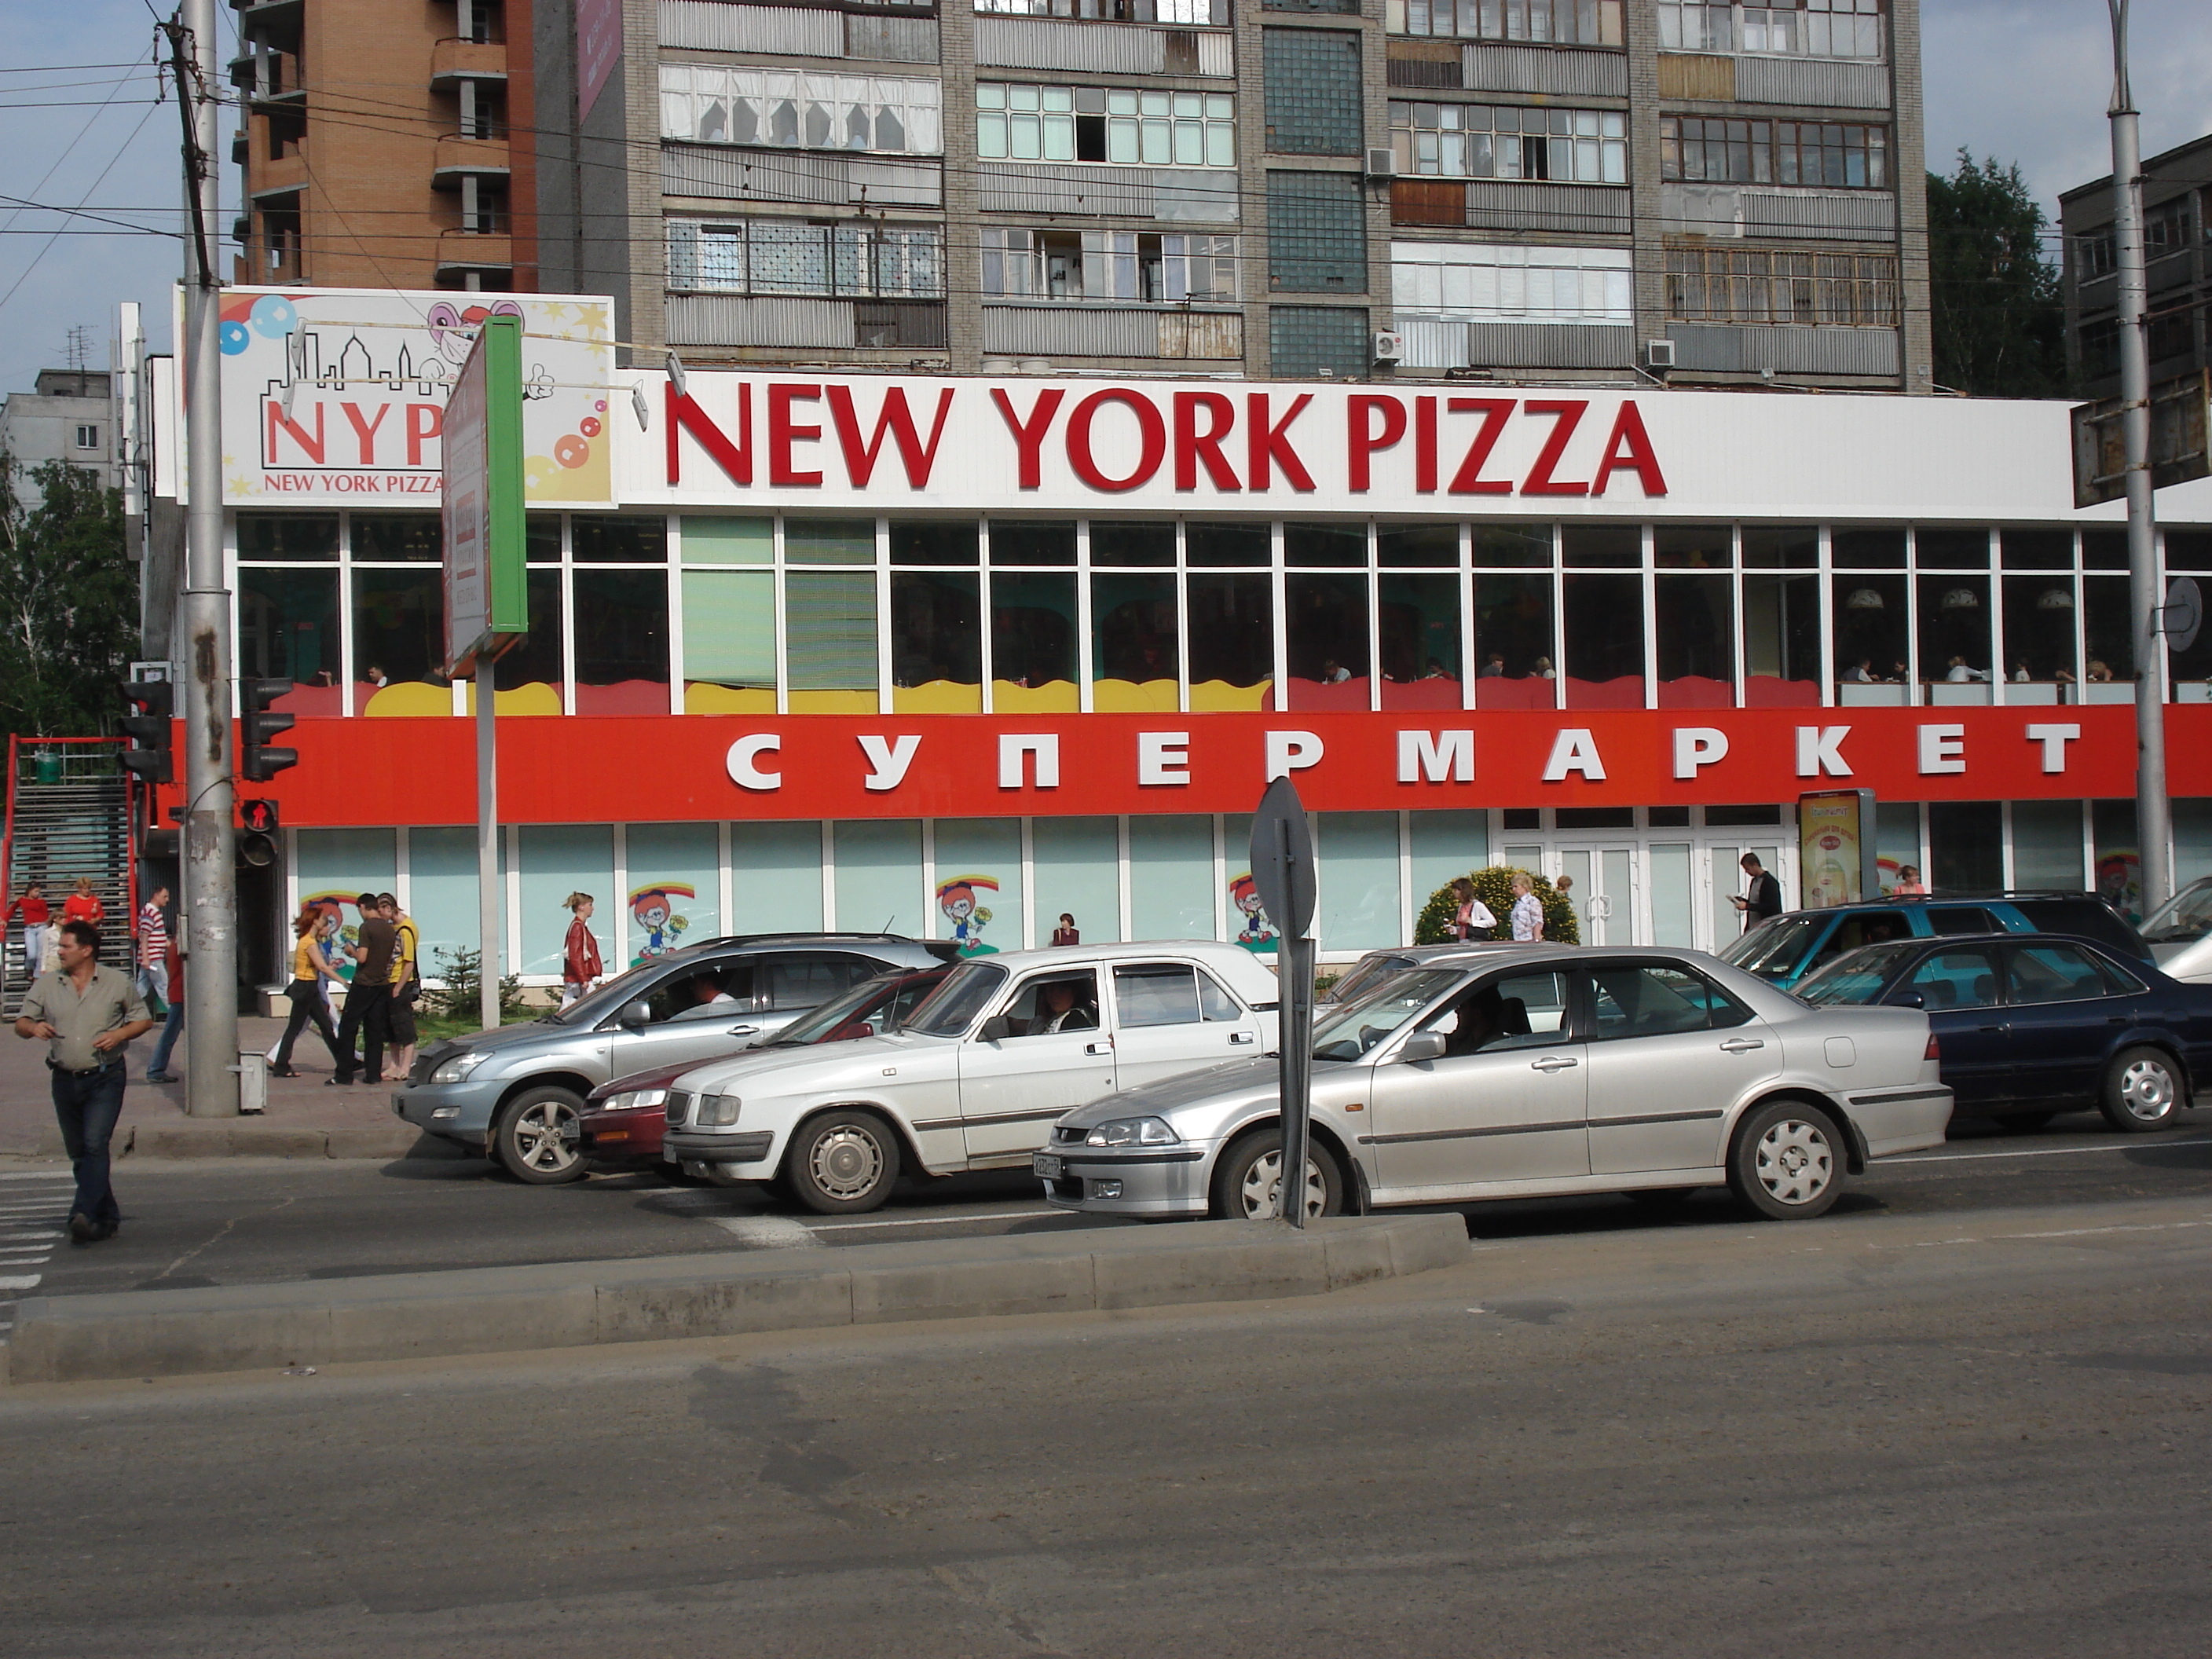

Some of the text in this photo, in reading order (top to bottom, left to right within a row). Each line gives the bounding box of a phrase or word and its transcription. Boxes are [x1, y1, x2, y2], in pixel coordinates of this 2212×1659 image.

[268, 401, 442, 465] NYP
[666, 381, 1668, 496] NEW YORK PIZZA
[265, 474, 314, 491] NEW
[321, 474, 380, 493] YORK
[726, 723, 2081, 791] СУПЕРМАРКЕТ
